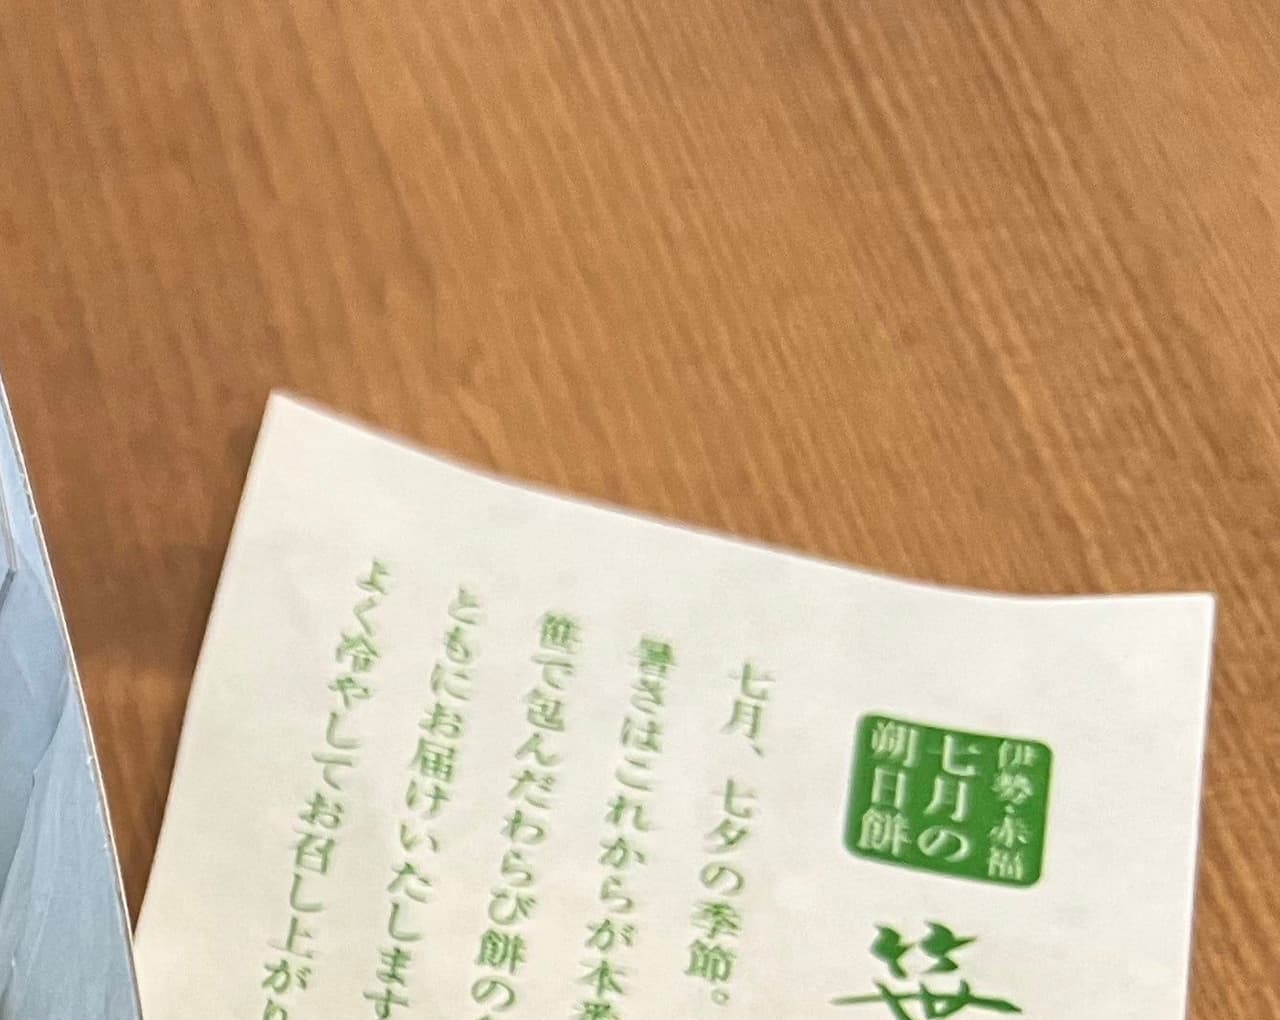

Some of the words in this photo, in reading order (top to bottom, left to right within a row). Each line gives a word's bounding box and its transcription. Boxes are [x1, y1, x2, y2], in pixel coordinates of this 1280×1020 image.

[682, 662, 777, 1006] 七月、七夕の季節。
[857, 718, 920, 858] 朔日餅
[916, 733, 982, 863] 七月の
